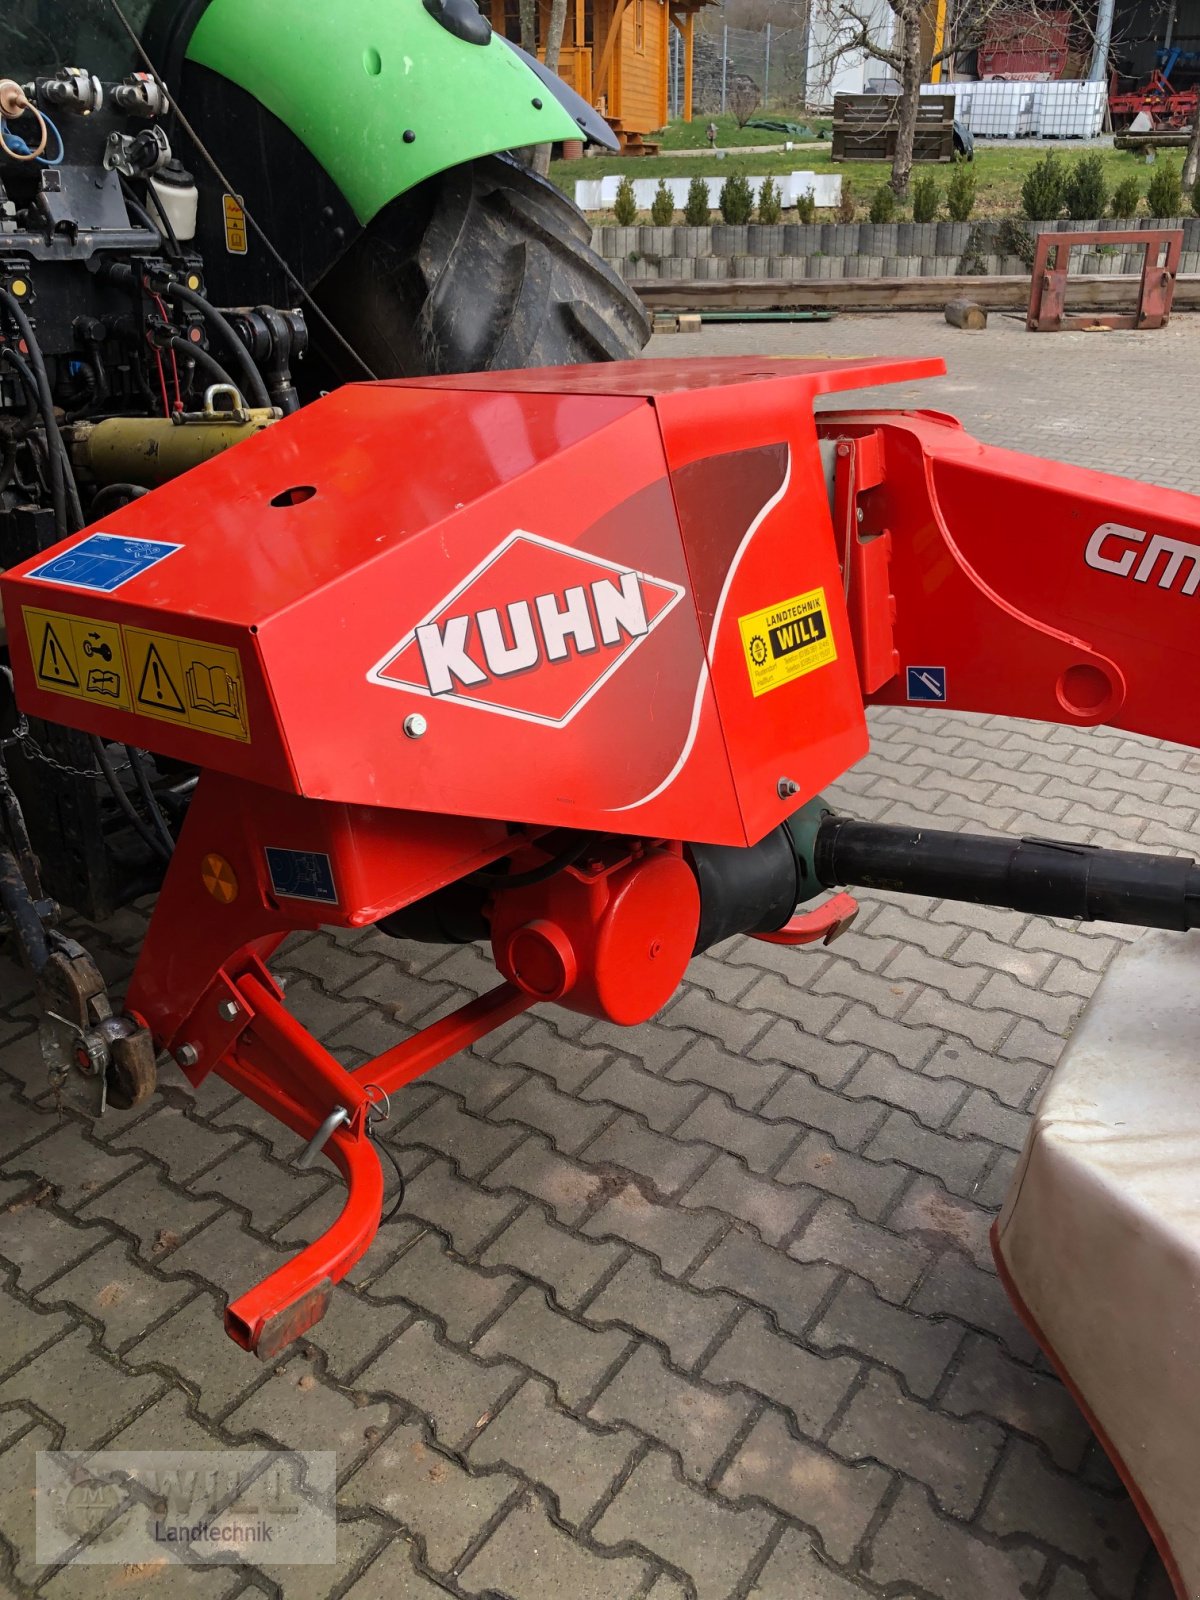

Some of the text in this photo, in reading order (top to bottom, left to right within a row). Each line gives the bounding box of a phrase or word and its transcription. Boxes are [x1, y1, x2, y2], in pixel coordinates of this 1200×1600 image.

[766, 598, 821, 627] LANDTECHNIK
[415, 571, 649, 696] KUHN
[777, 617, 819, 651] WILL
